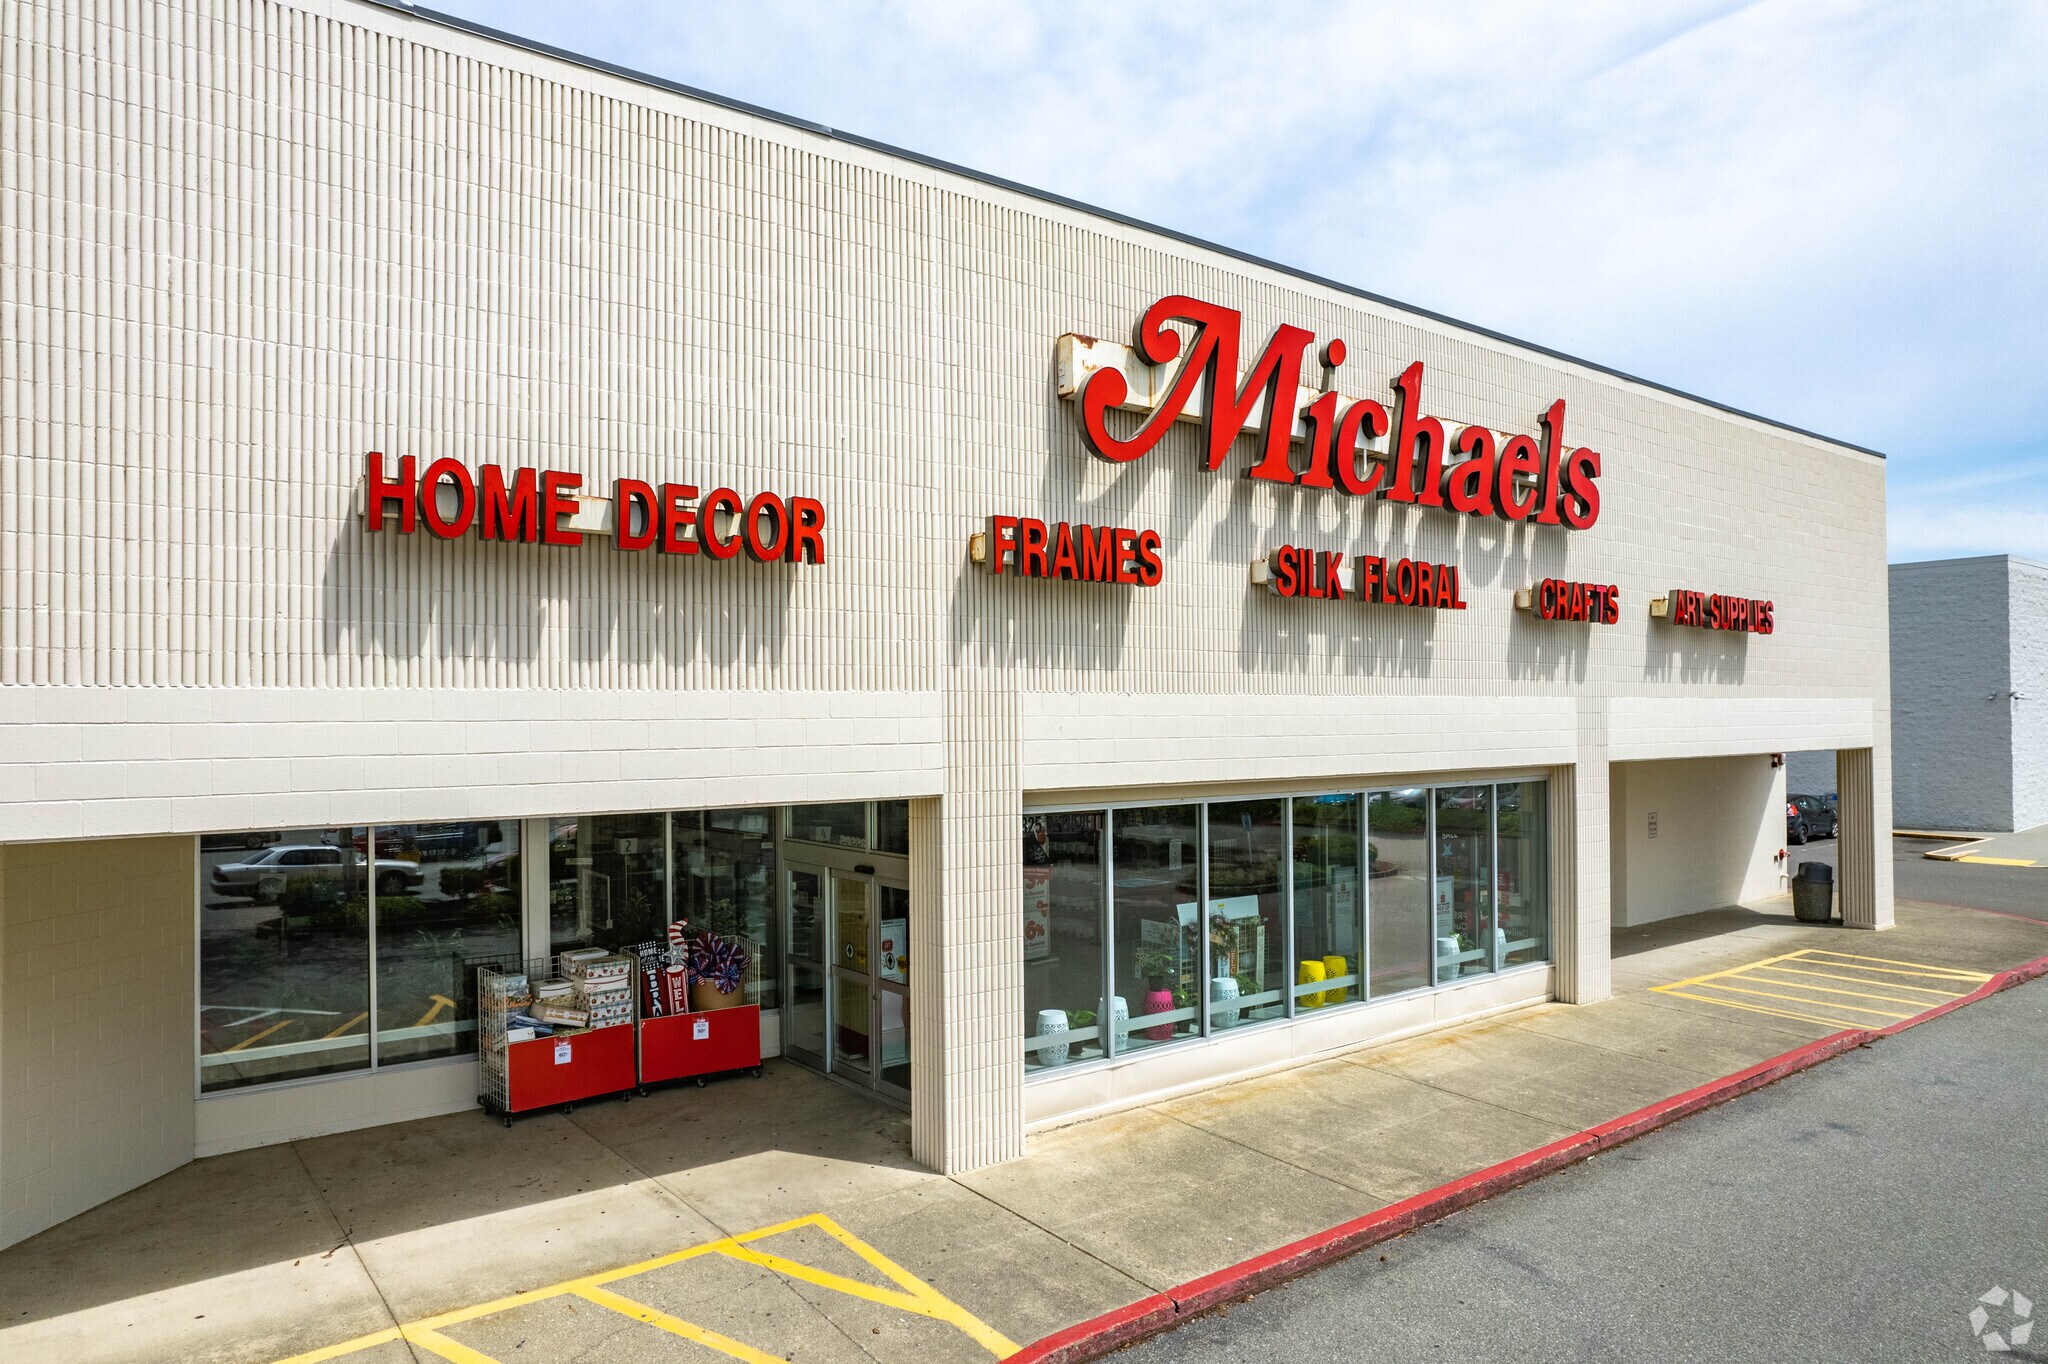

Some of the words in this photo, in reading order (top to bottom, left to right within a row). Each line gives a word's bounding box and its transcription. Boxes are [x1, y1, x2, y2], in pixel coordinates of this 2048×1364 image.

[1076, 295, 1601, 530] Michaels
[366, 451, 583, 547] HOME
[615, 477, 826, 565] DECOR
[990, 515, 1163, 587] FRAMES
[1274, 544, 1345, 600] SILK
[1360, 556, 1468, 610] FLORAL
[1537, 578, 1620, 625] CRAFTS
[1673, 589, 1706, 627] ART
[1707, 593, 1774, 635] SUPPLIES
[625, 840, 632, 852] 2
[640, 947, 658, 957] HOME
[1025, 920, 1046, 940] 6%
[671, 976, 685, 1015] WEL
